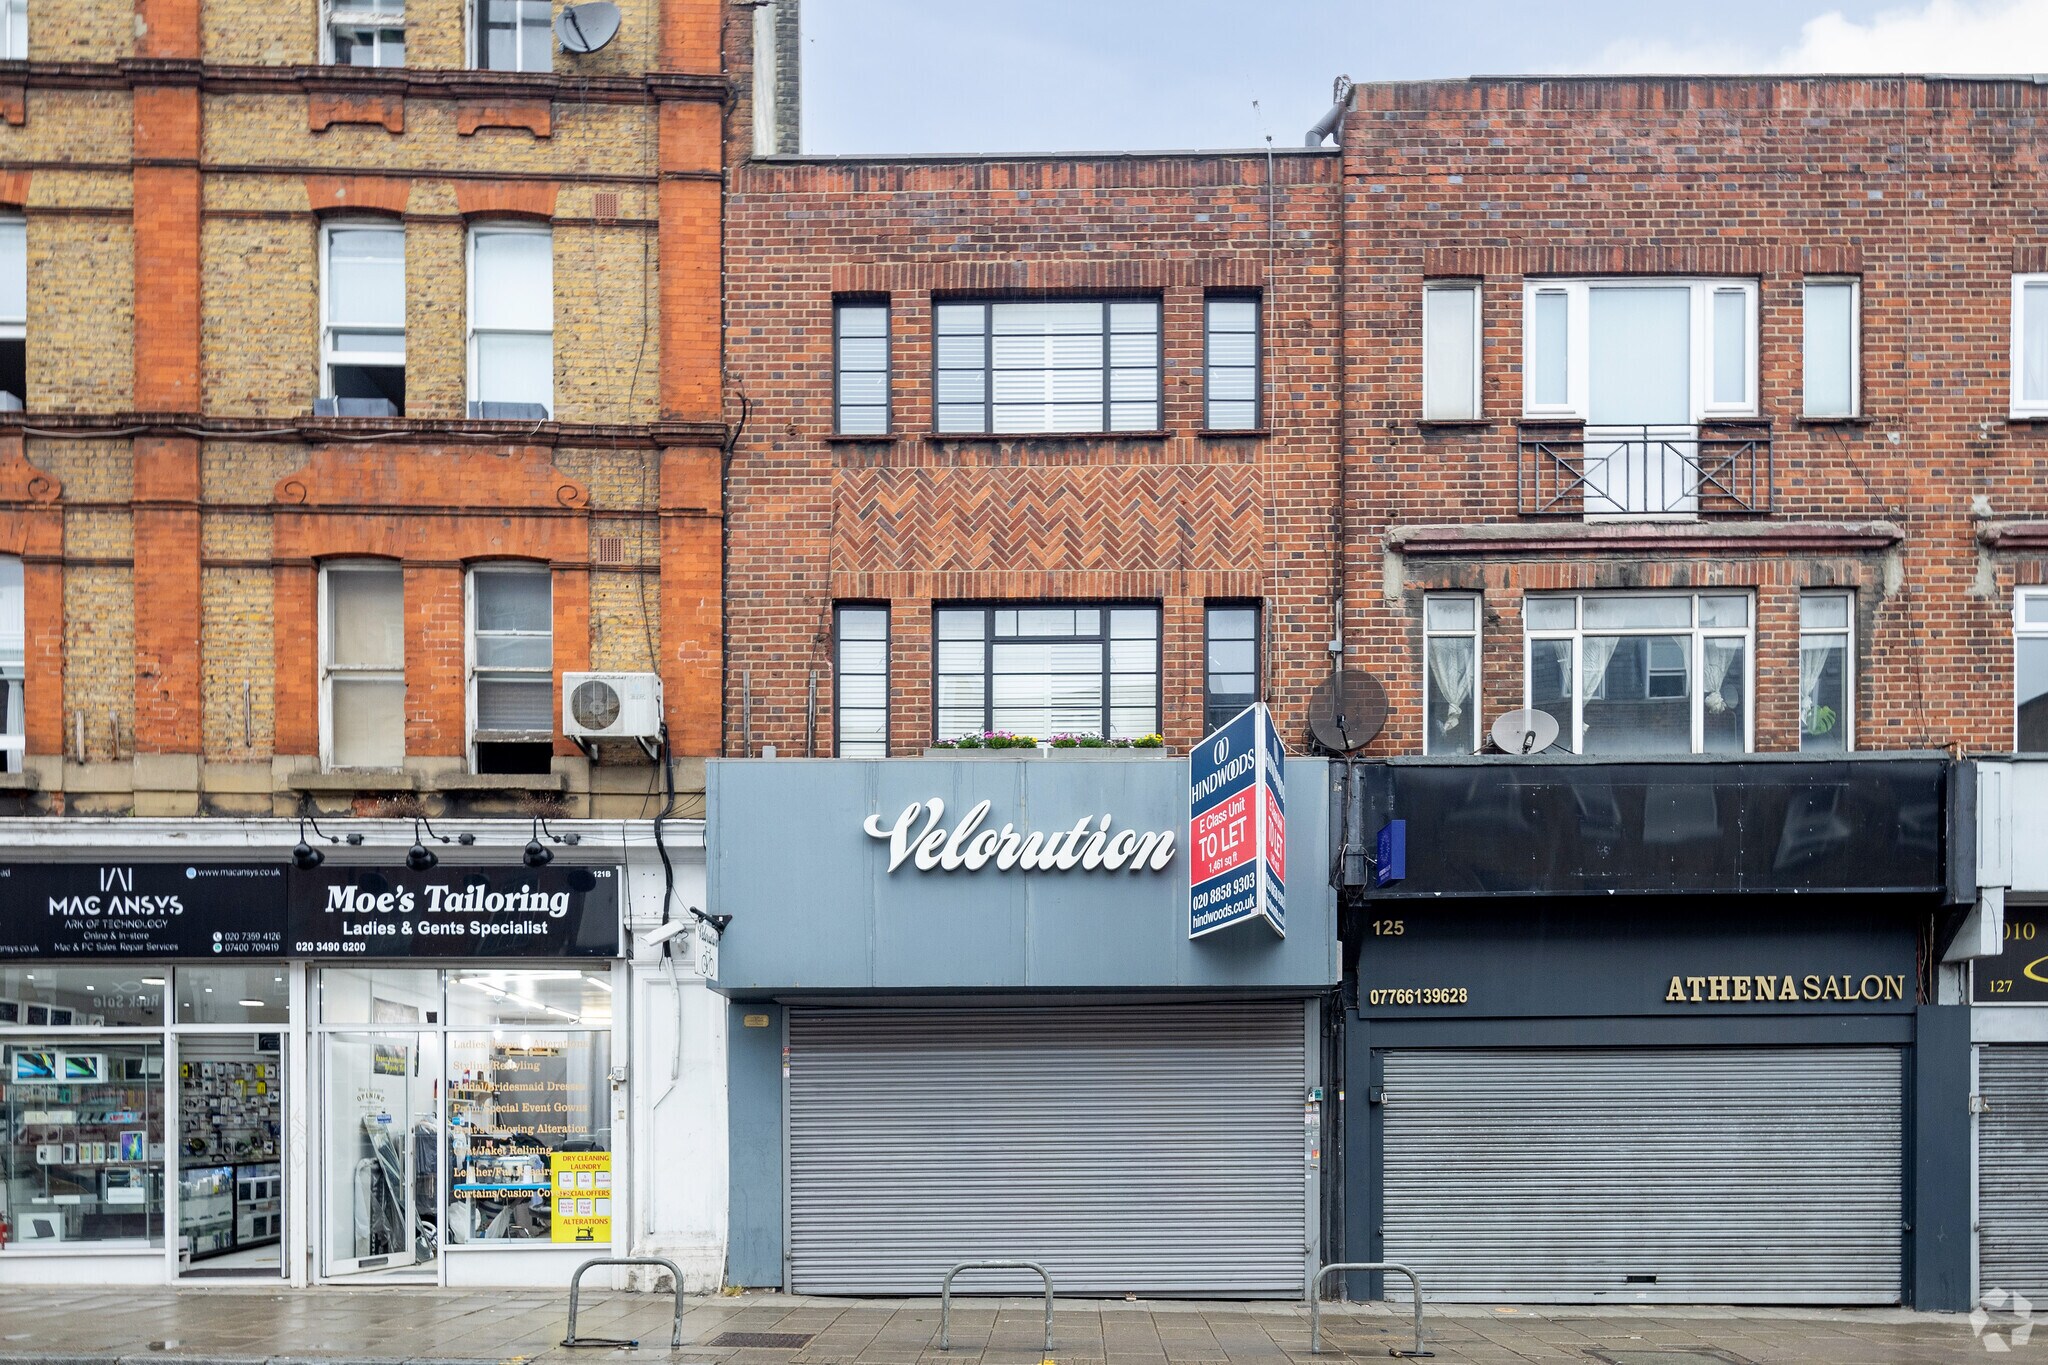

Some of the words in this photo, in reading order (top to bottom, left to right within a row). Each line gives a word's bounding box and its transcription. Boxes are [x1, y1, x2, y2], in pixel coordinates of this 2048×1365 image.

[1191, 748, 1255, 804] HINDWOODS
[1199, 818, 1206, 834] E
[1206, 810, 1227, 829] Class
[1228, 797, 1246, 817] Unit
[863, 797, 1176, 873] Velorution
[1199, 832, 1218, 861] TO
[1221, 816, 1247, 852] LET
[1208, 858, 1224, 873] 1,461
[1224, 856, 1232, 867] sq
[1233, 851, 1238, 863] ft
[198, 867, 281, 879] www.macansys.co.uk
[593, 870, 612, 878] 121B
[1192, 892, 1208, 911] 020
[1210, 882, 1232, 904] 8858
[1233, 872, 1255, 895] 9303
[49, 895, 101, 916] MAC
[107, 895, 184, 916] ANSYS
[324, 884, 415, 914] Moe's
[423, 884, 571, 919] Tailoring
[1192, 893, 1255, 928] hindwoods.co.uk
[64, 919, 83, 930] ARK
[85, 919, 100, 930] OF
[102, 919, 169, 930] TECHNOLOGY
[343, 920, 397, 936] Ladies
[401, 920, 414, 936] &
[417, 920, 465, 936] Gents
[469, 920, 548, 938] Specialist
[1372, 919, 1405, 936] 125
[83, 931, 109, 941] Online
[110, 931, 117, 941] &
[224, 931, 240, 942] 020
[263, 931, 281, 942] 4126
[54, 942, 71, 952] Mac
[72, 942, 80, 952] &
[81, 942, 94, 952] PC
[119, 942, 144, 954] Repair
[146, 942, 179, 952] Services
[224, 942, 249, 953] 07400
[251, 942, 280, 953] 709419
[295, 941, 314, 952] 020
[316, 941, 340, 952] 3490
[342, 941, 367, 952] 6200
[1989, 979, 2013, 993] 127
[1369, 987, 1468, 1006] 07766139628
[453, 1039, 487, 1050] Ladies
[357, 1093, 385, 1102] OPENING
[522, 1102, 551, 1114] Event
[553, 1102, 588, 1114] Gowns
[488, 1124, 534, 1136] Tailoring
[536, 1123, 588, 1134] Alteration
[509, 1145, 553, 1158] Relining
[453, 1187, 535, 1199] Curtains/Cusion
